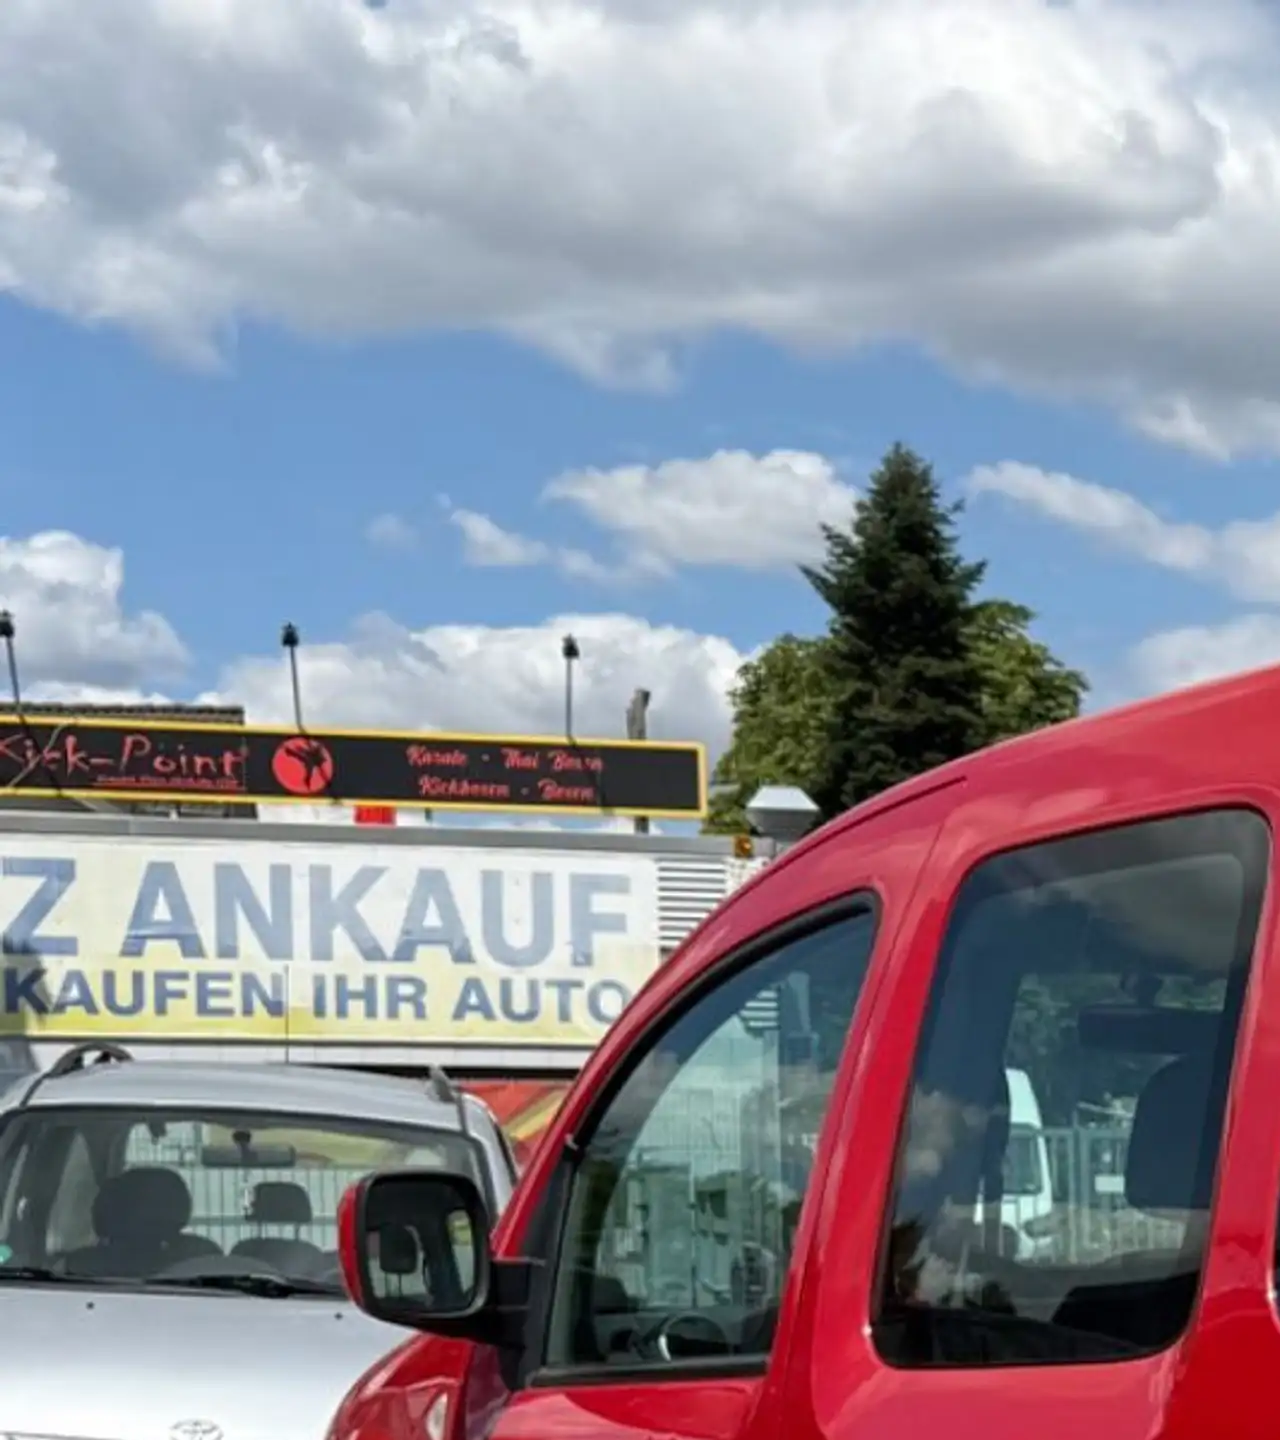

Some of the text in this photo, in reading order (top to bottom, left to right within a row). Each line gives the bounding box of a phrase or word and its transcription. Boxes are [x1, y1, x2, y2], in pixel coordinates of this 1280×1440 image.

[118, 860, 631, 968] ANKAUF
[3, 967, 632, 1025] KAUFEN IHR AUTO
